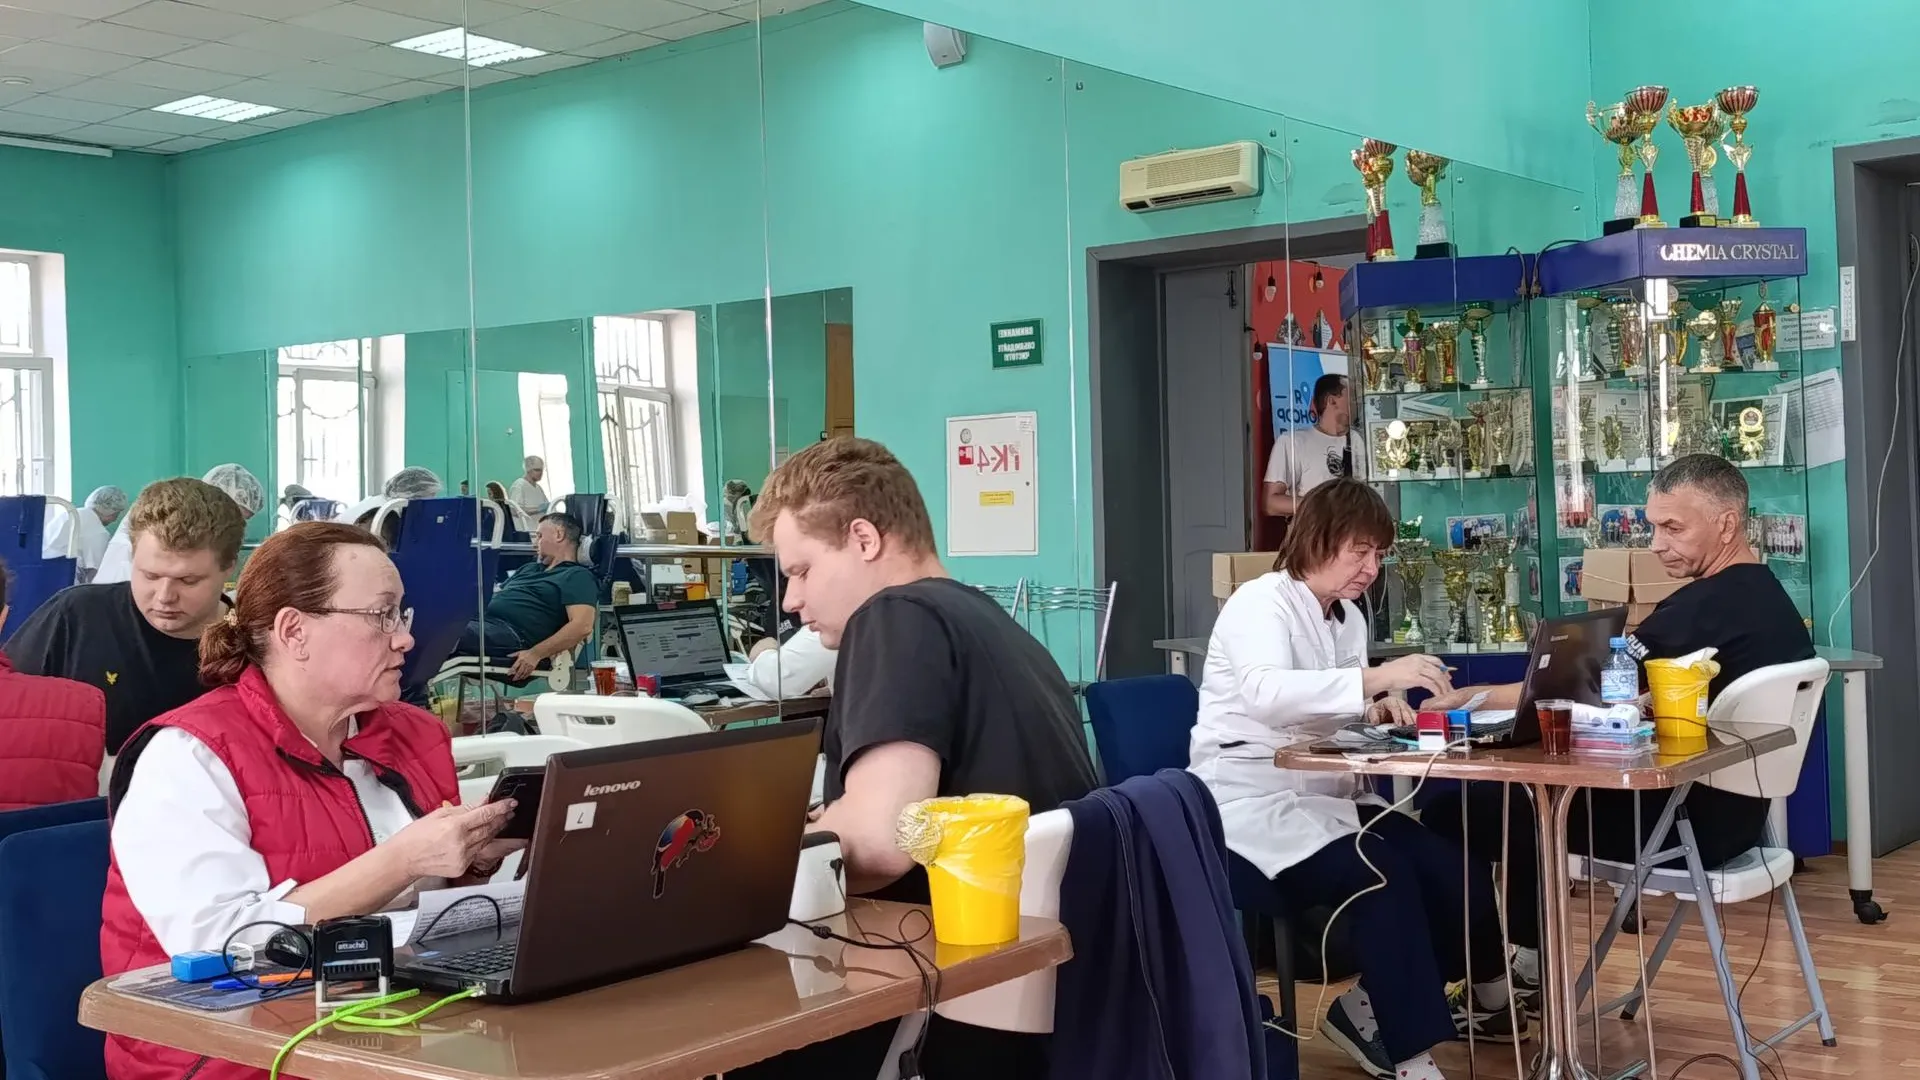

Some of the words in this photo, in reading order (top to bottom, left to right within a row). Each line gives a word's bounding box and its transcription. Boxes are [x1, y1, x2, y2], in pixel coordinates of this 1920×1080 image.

[1660, 243, 1729, 261] CHEMIA
[1731, 243, 1800, 260] CRYSTAL
[583, 780, 642, 797] lenovo
